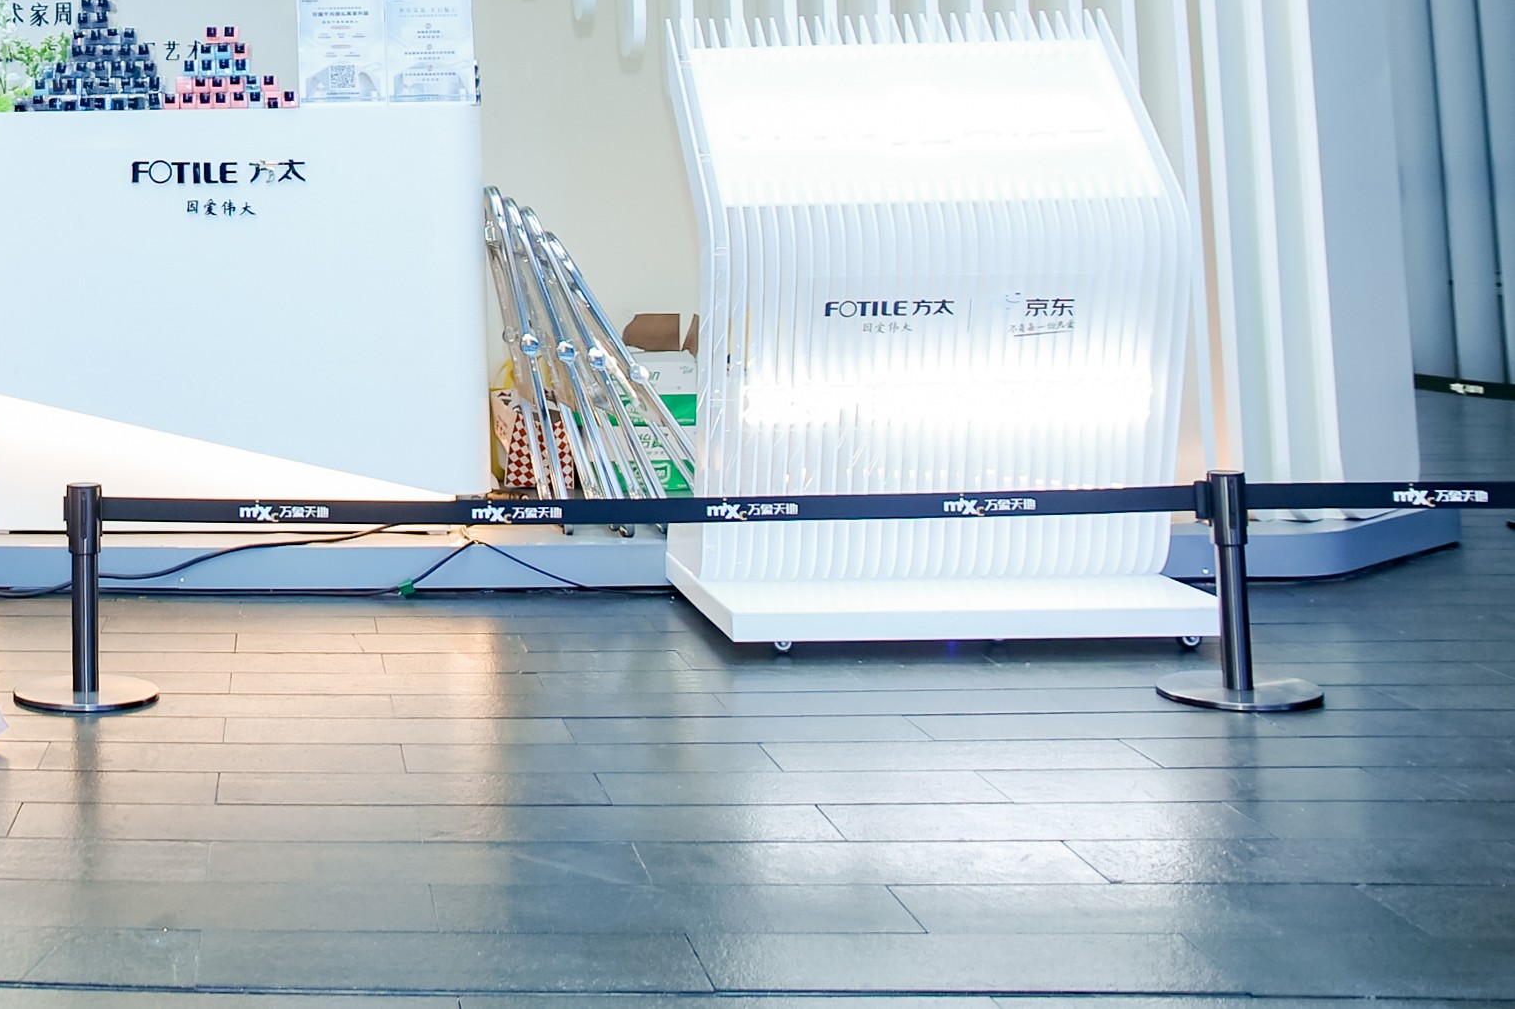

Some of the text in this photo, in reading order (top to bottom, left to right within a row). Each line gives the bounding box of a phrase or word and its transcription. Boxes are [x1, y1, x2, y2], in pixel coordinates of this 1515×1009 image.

[131, 158, 307, 184] FOTILE 方太
[186, 198, 257, 217] 因爱伟大
[824, 298, 955, 318] FOTILE 方太
[1024, 297, 1076, 317] 京东
[862, 321, 914, 334] 因爱伟大
